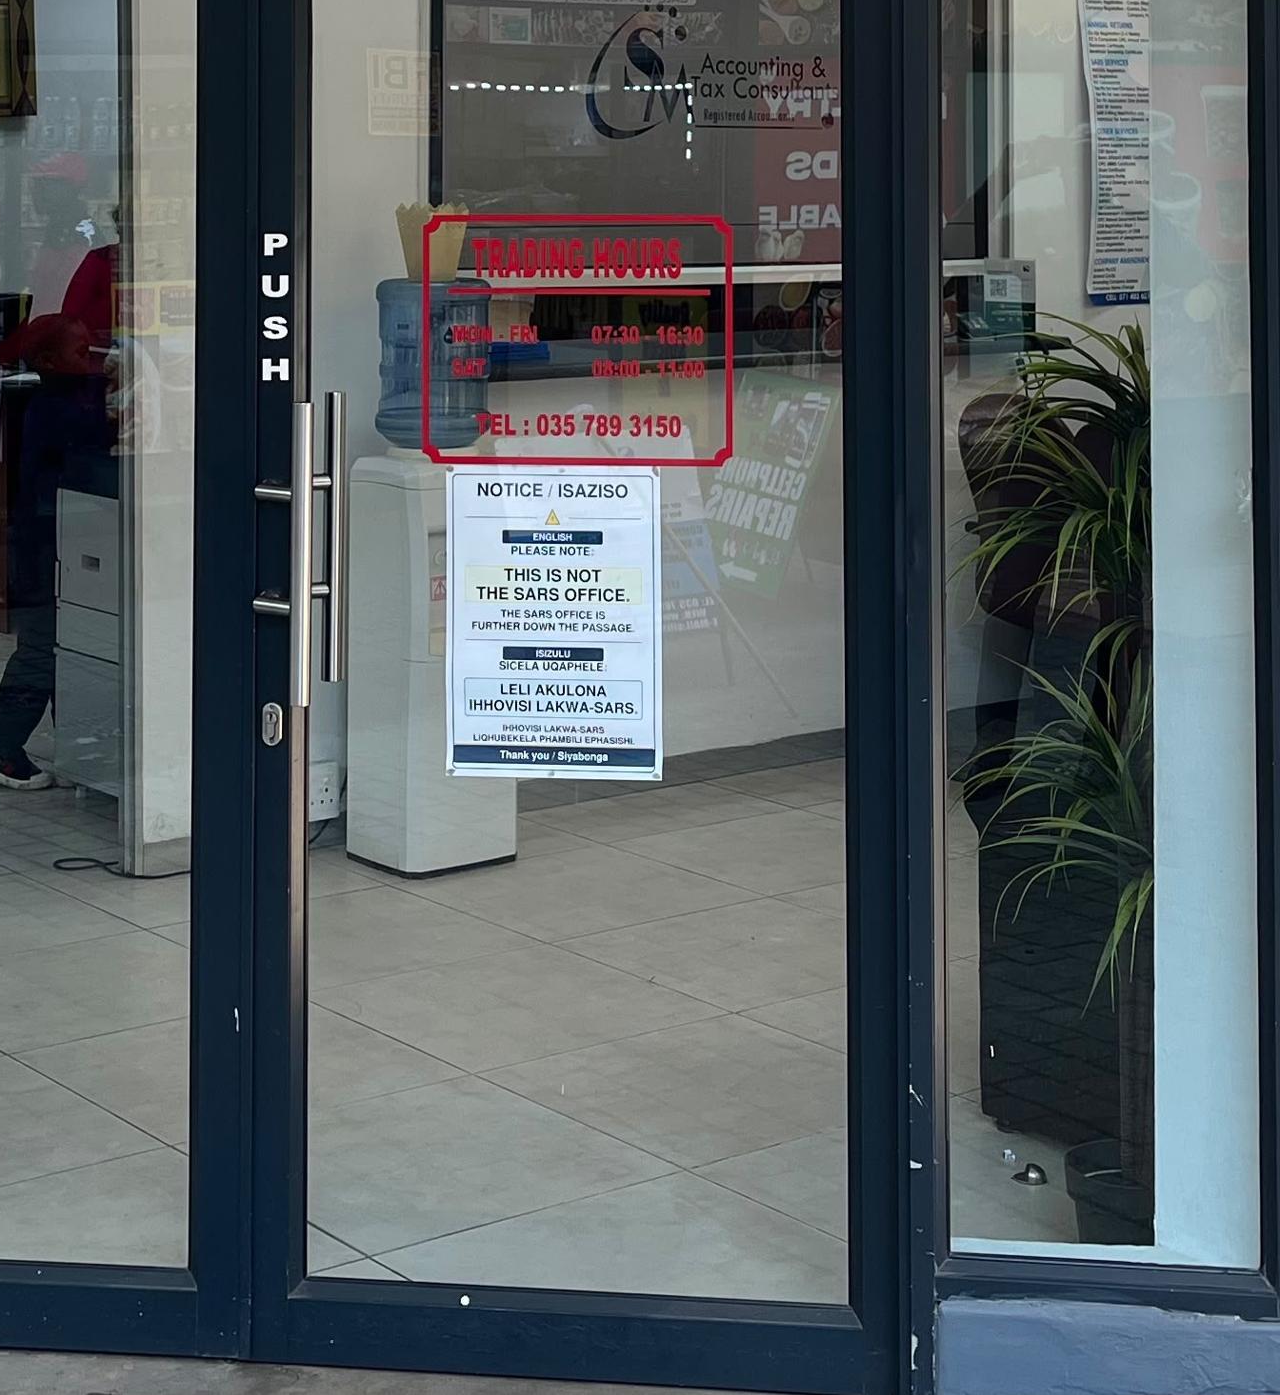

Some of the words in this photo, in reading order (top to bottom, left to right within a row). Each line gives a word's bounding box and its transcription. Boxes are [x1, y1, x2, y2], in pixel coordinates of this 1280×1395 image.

[700, 53, 804, 81] Accounting
[811, 56, 826, 78] &
[690, 75, 724, 99] Tax
[471, 237, 585, 279] TRADING
[592, 236, 683, 279] HOURS
[261, 233, 290, 381] PUSH
[591, 325, 641, 345] 07:30
[656, 325, 704, 346] 16:30
[475, 413, 516, 436] TEL
[536, 413, 576, 437] 035
[582, 414, 622, 437] 789
[628, 414, 682, 438] 3150
[477, 482, 543, 498] NOTICE
[558, 483, 628, 499] ISAZISO
[532, 532, 573, 542] ENGLISH
[511, 545, 556, 556] PLEASE
[504, 568, 542, 582] THIS
[546, 568, 562, 582] IS
[567, 569, 602, 583] NOT
[476, 586, 509, 600] THE
[513, 587, 560, 602] SARS
[564, 588, 631, 603] OFFICE.
[501, 609, 521, 619] THE
[523, 609, 553, 619] SARS
[555, 610, 593, 620] OFFICE
[596, 611, 606, 620] IS
[472, 621, 520, 632] FURTHER
[523, 622, 556, 632] DOWN
[559, 622, 579, 632] THE
[535, 649, 571, 659] ISIZULU
[499, 661, 539, 672] SICELA
[500, 683, 531, 696] LELI
[535, 684, 607, 697] AKULONA
[469, 699, 532, 712] IHHOVISI
[536, 700, 638, 715] LAKWA-SARS.
[502, 724, 542, 733] IHHOVISI
[544, 725, 605, 734] LAKWA-SARS
[499, 750, 529, 761] Thank
[531, 752, 550, 762] you
[557, 751, 609, 763] Siyabonga
